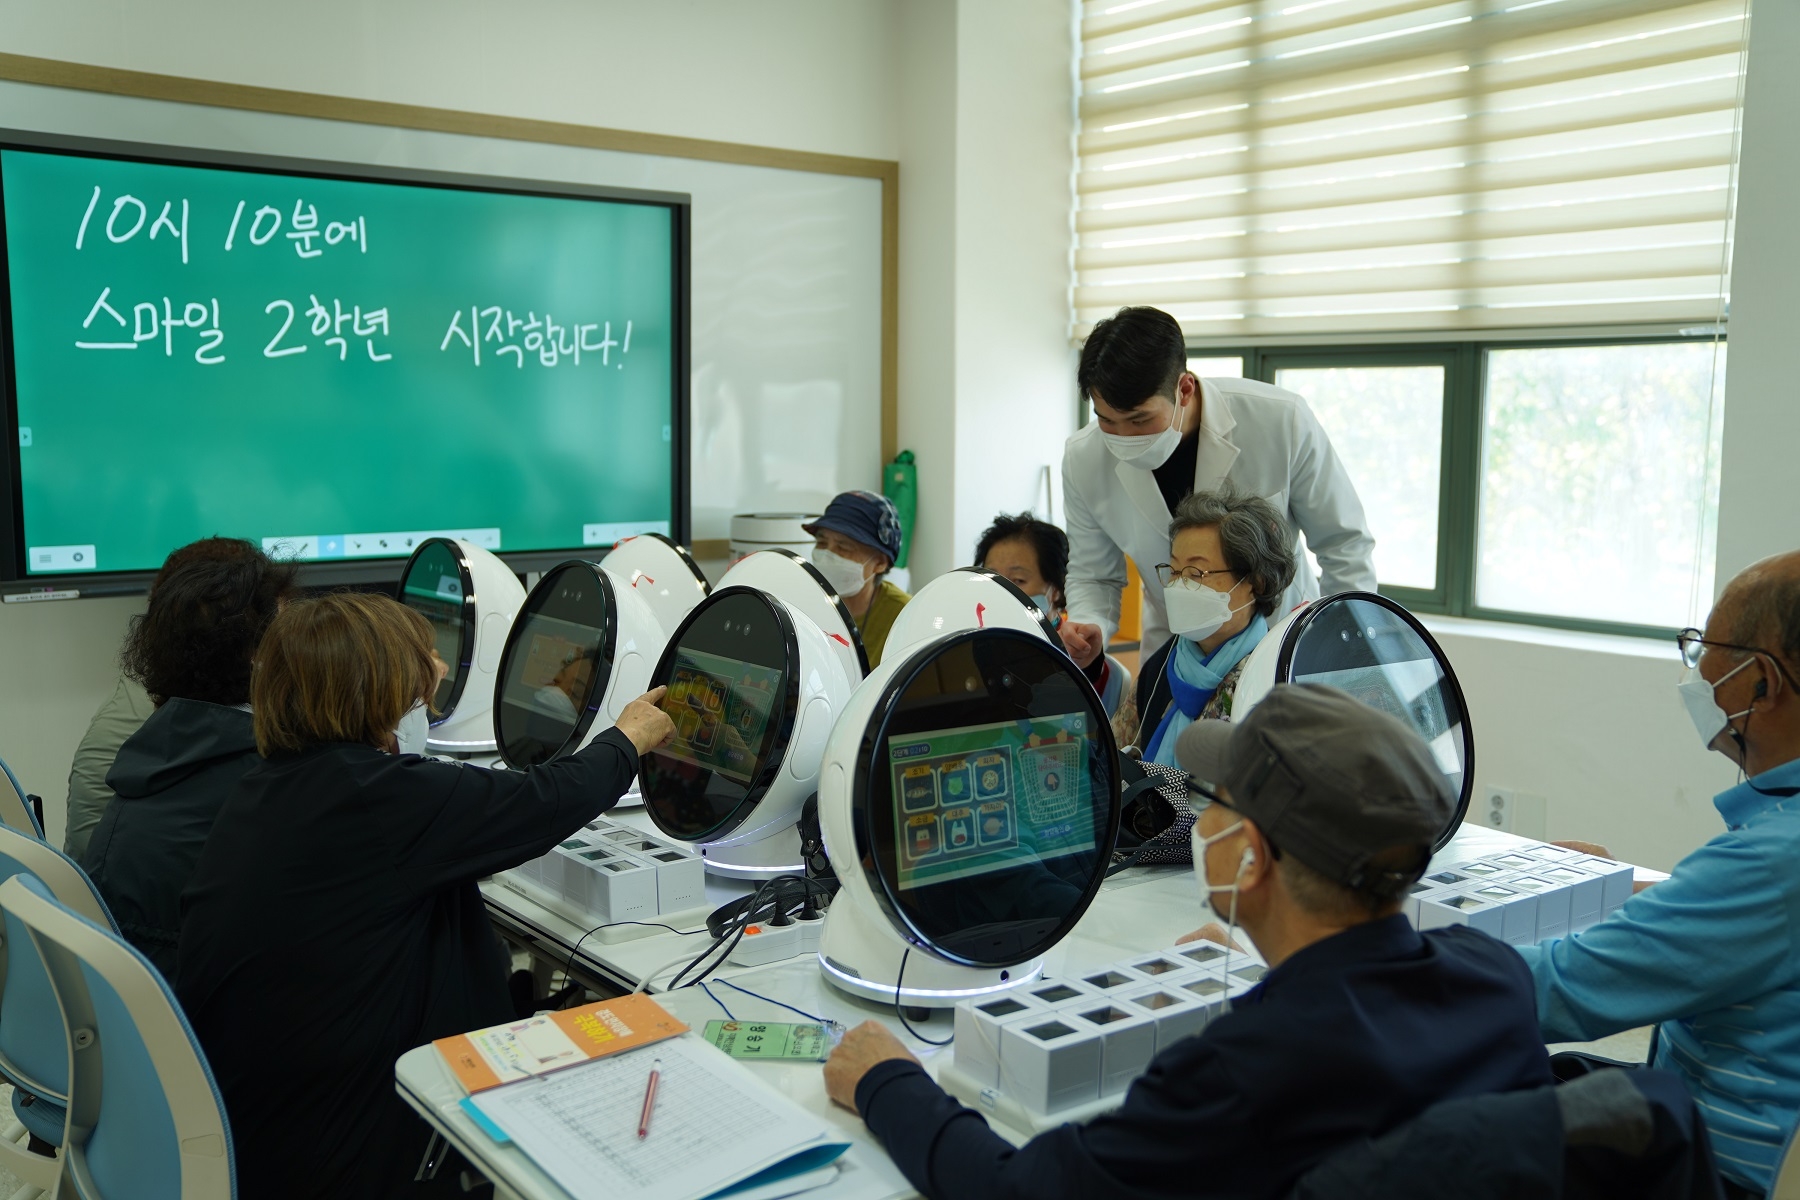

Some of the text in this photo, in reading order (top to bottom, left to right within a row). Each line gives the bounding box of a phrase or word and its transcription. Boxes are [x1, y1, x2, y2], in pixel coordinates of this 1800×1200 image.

[76, 186, 368, 263] 10시 10분에
[76, 288, 633, 371] 스마일 2학년 시작합니다!
